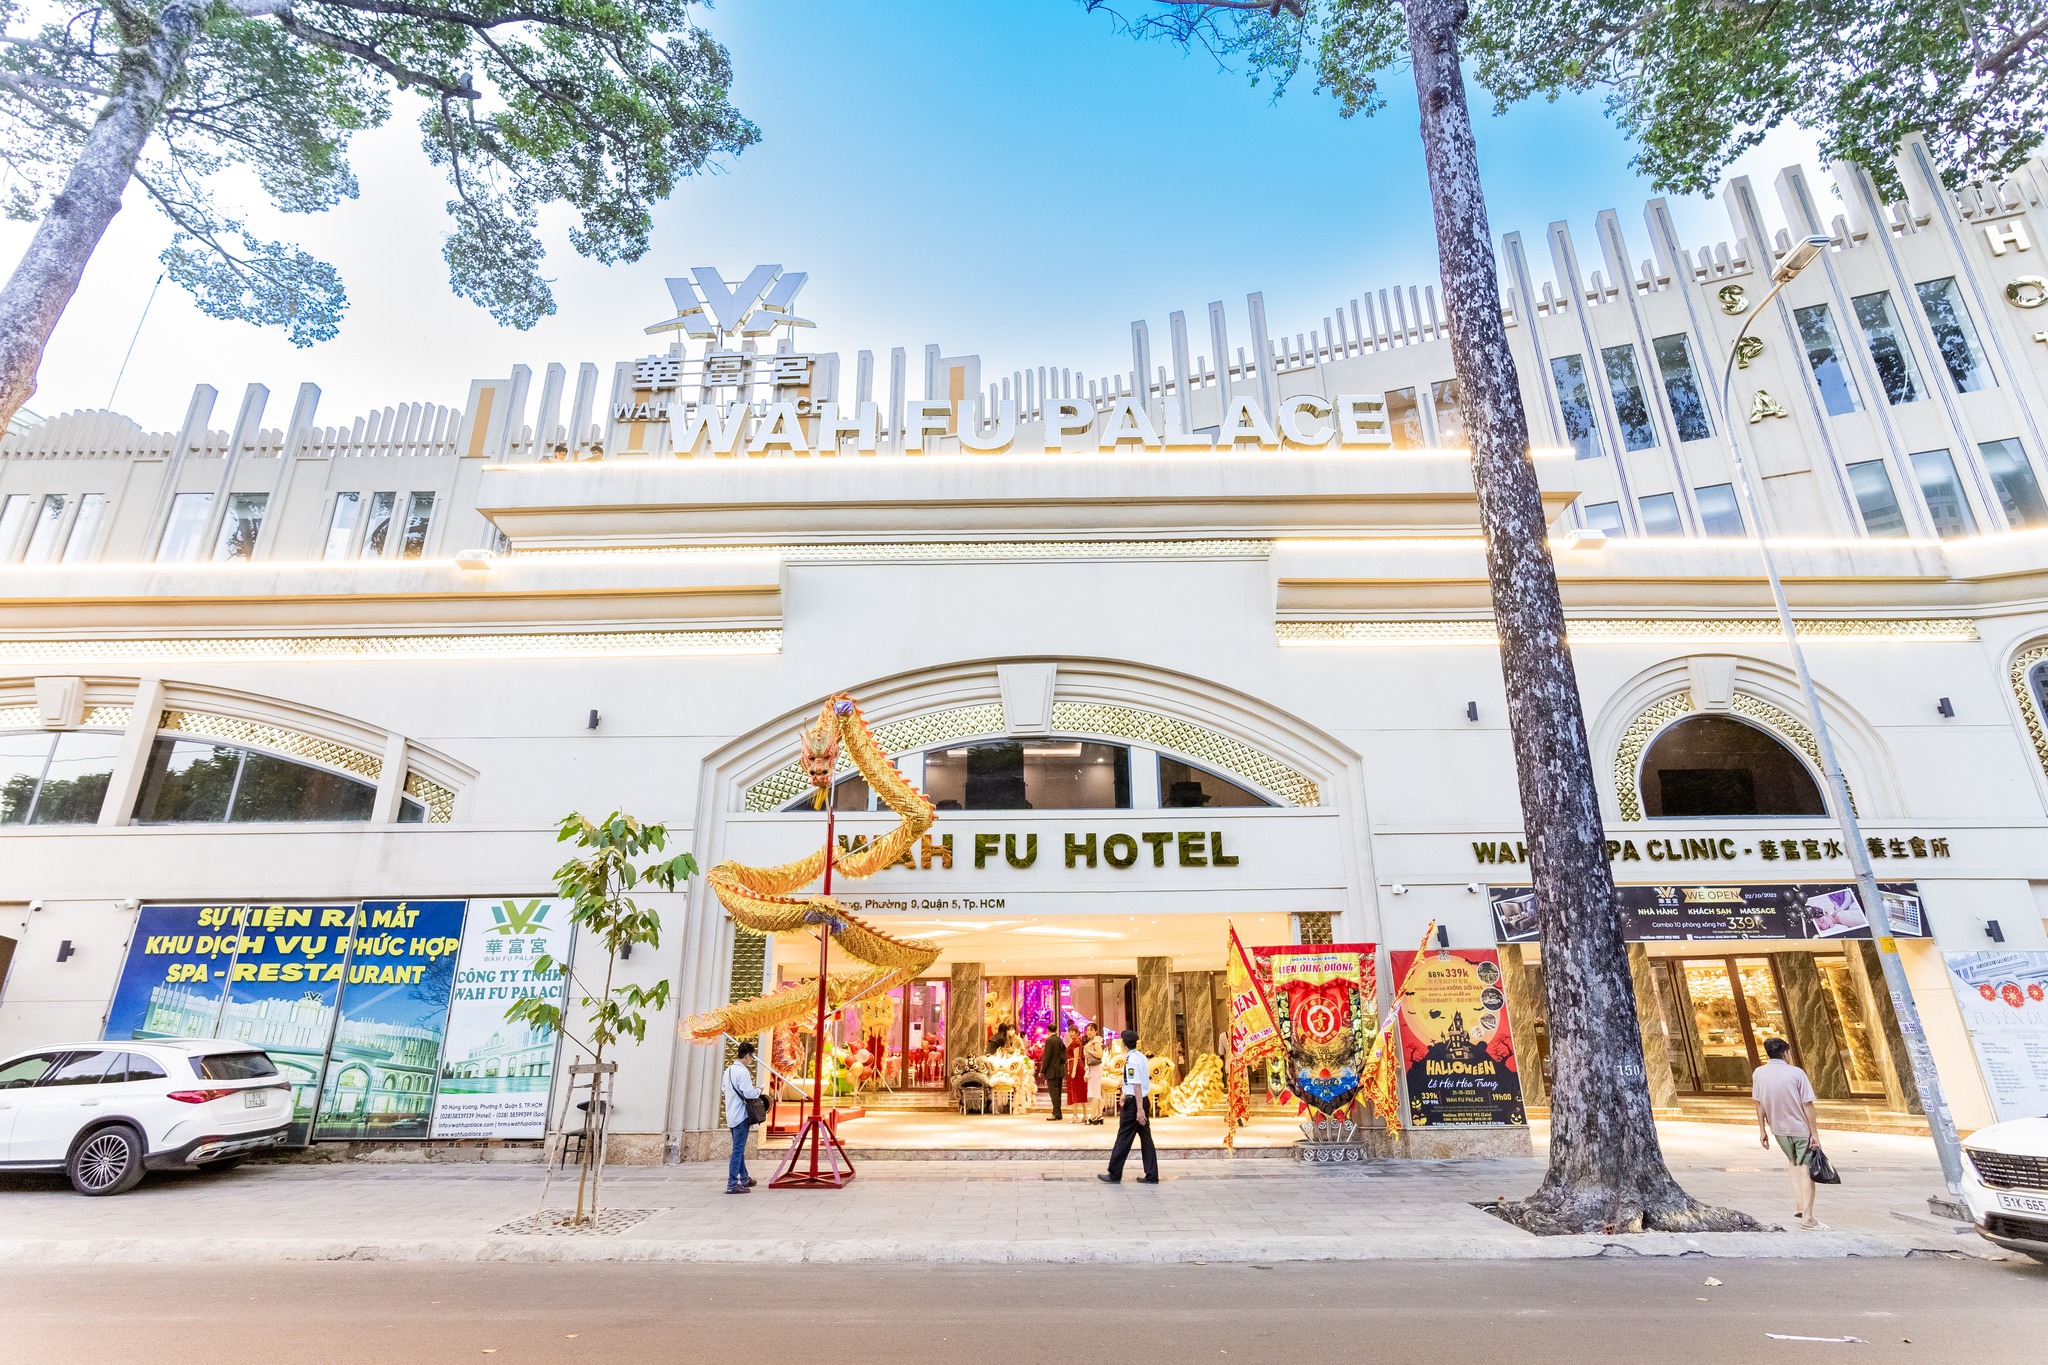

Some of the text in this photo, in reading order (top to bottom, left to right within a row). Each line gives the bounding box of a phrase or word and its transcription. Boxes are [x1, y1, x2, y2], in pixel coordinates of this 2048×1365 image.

[1718, 284, 1789, 424] SPA
[631, 348, 816, 393] 華富宮
[669, 394, 1393, 460] WAH FU PALACE
[974, 832, 1038, 869] FU
[1064, 831, 1239, 868] HOTEL
[1646, 837, 1738, 861] CLINIC
[1759, 836, 1951, 861] 華富宮水養生會所
[1686, 890, 1740, 901] WE OPEN
[921, 899, 948, 912] Quận
[963, 898, 978, 910] Tp.
[980, 898, 1005, 909] HCM
[1638, 907, 1656, 916] NHÀ
[1656, 907, 1679, 916] HÀNG
[1688, 906, 1715, 915] KHÁCH
[1739, 907, 1777, 915] MASSAGE
[197, 902, 419, 933] SỰ KIỆN RA MẮT
[144, 933, 459, 966] KHU DỊCH VỤ PHỨC HỢP
[486, 937, 548, 955] 華富宮
[484, 955, 501, 963] WAH
[165, 963, 208, 984] SPA
[231, 962, 426, 985] RESTAURANT
[458, 967, 497, 984] CÔNG
[500, 970, 520, 983] TY
[1445, 968, 1470, 978] 339k
[488, 987, 508, 1001] FU
[1426, 1059, 1496, 1076] HALLOWEEN
[1474, 1078, 1499, 1091] Trang
[1421, 1092, 1438, 1100] 339k
[1492, 1093, 1512, 1101] 19h00
